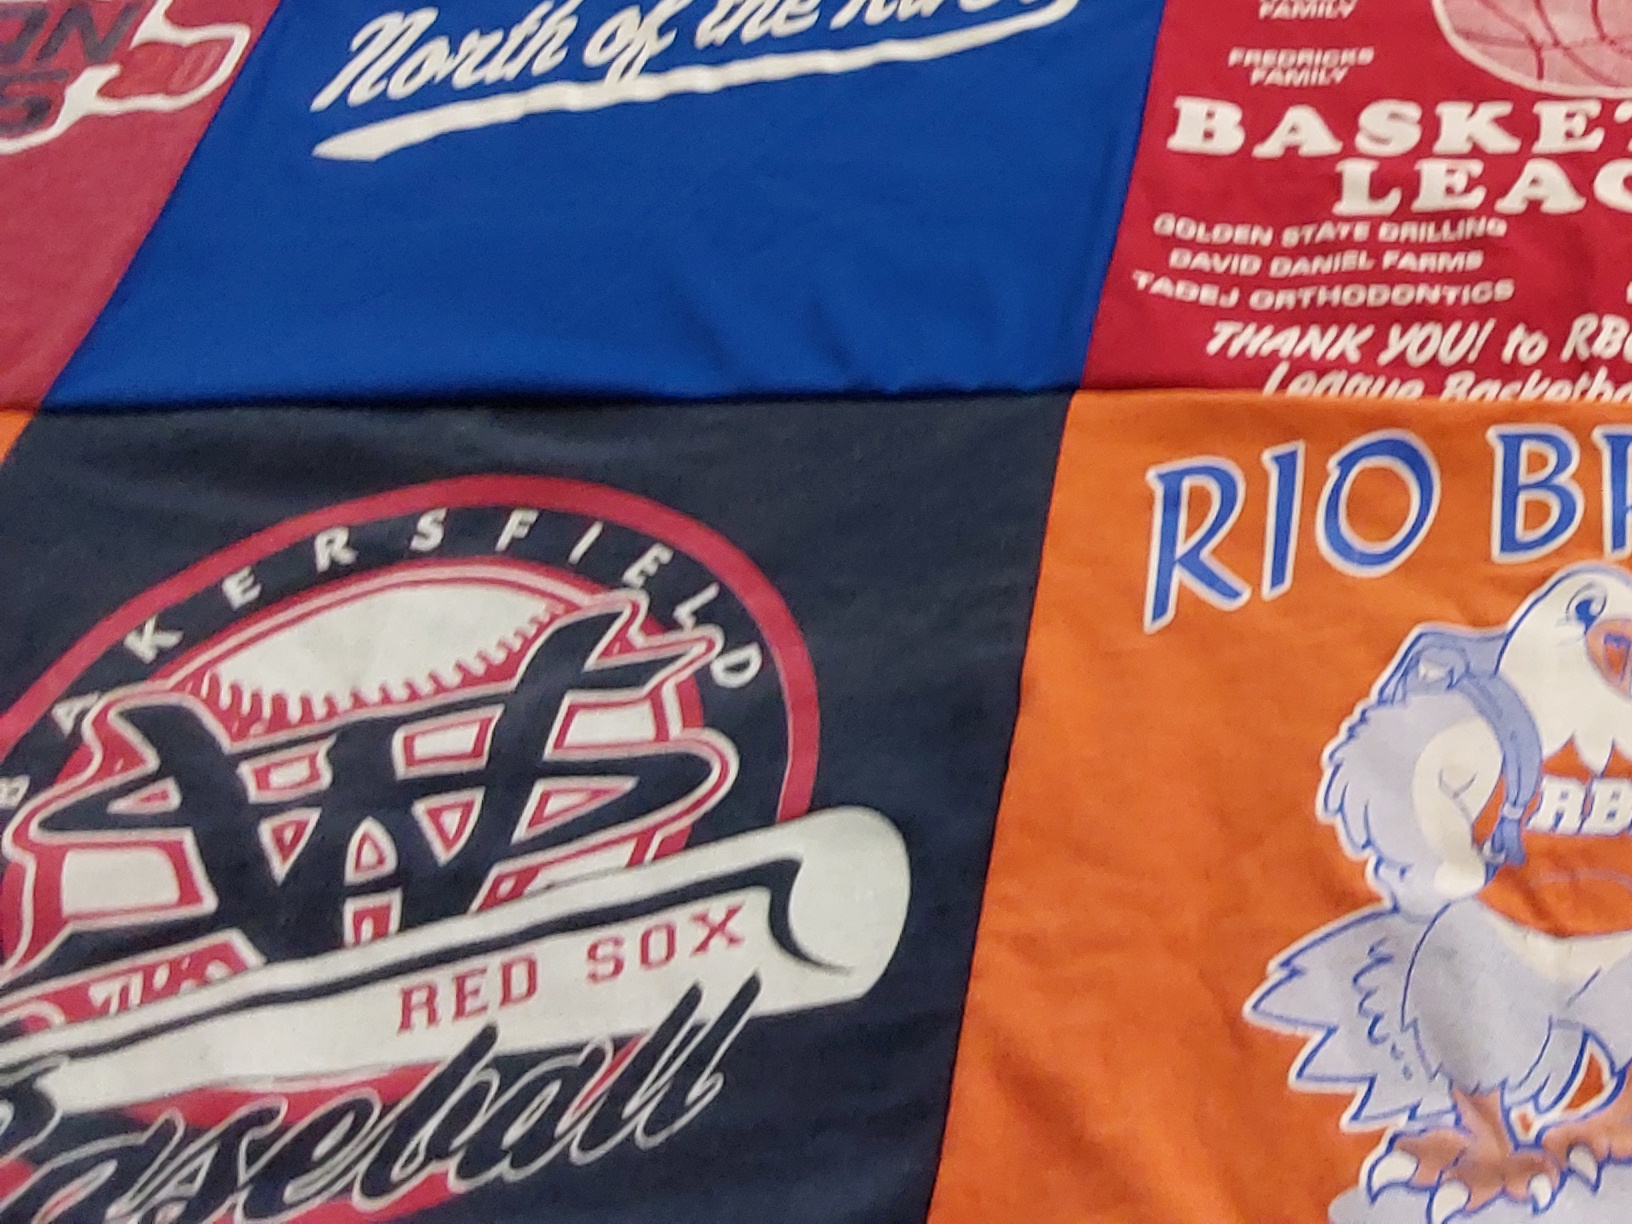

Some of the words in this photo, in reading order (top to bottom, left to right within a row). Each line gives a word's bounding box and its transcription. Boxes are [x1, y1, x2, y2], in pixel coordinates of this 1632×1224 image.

[1259, 1, 1355, 19] FAMILY
[1250, 67, 1350, 87] FAMILY
[1153, 212, 1273, 247] GOLDEN
[1281, 219, 1371, 248] STATE
[1378, 215, 1508, 245] DRILLING
[1169, 247, 1262, 276] DAVID
[1268, 248, 1375, 278] DANIEL
[1381, 249, 1484, 274] FARMS
[1249, 279, 1515, 312] ORTHODONTICS
[1206, 320, 1375, 364] THANK
[1377, 317, 1496, 369] YOU!
[1503, 323, 1548, 367] to
[1143, 428, 1438, 634] RIO
[396, 956, 539, 1036] RED
[587, 905, 749, 985] SOX
[0, 970, 762, 1224] aseball
